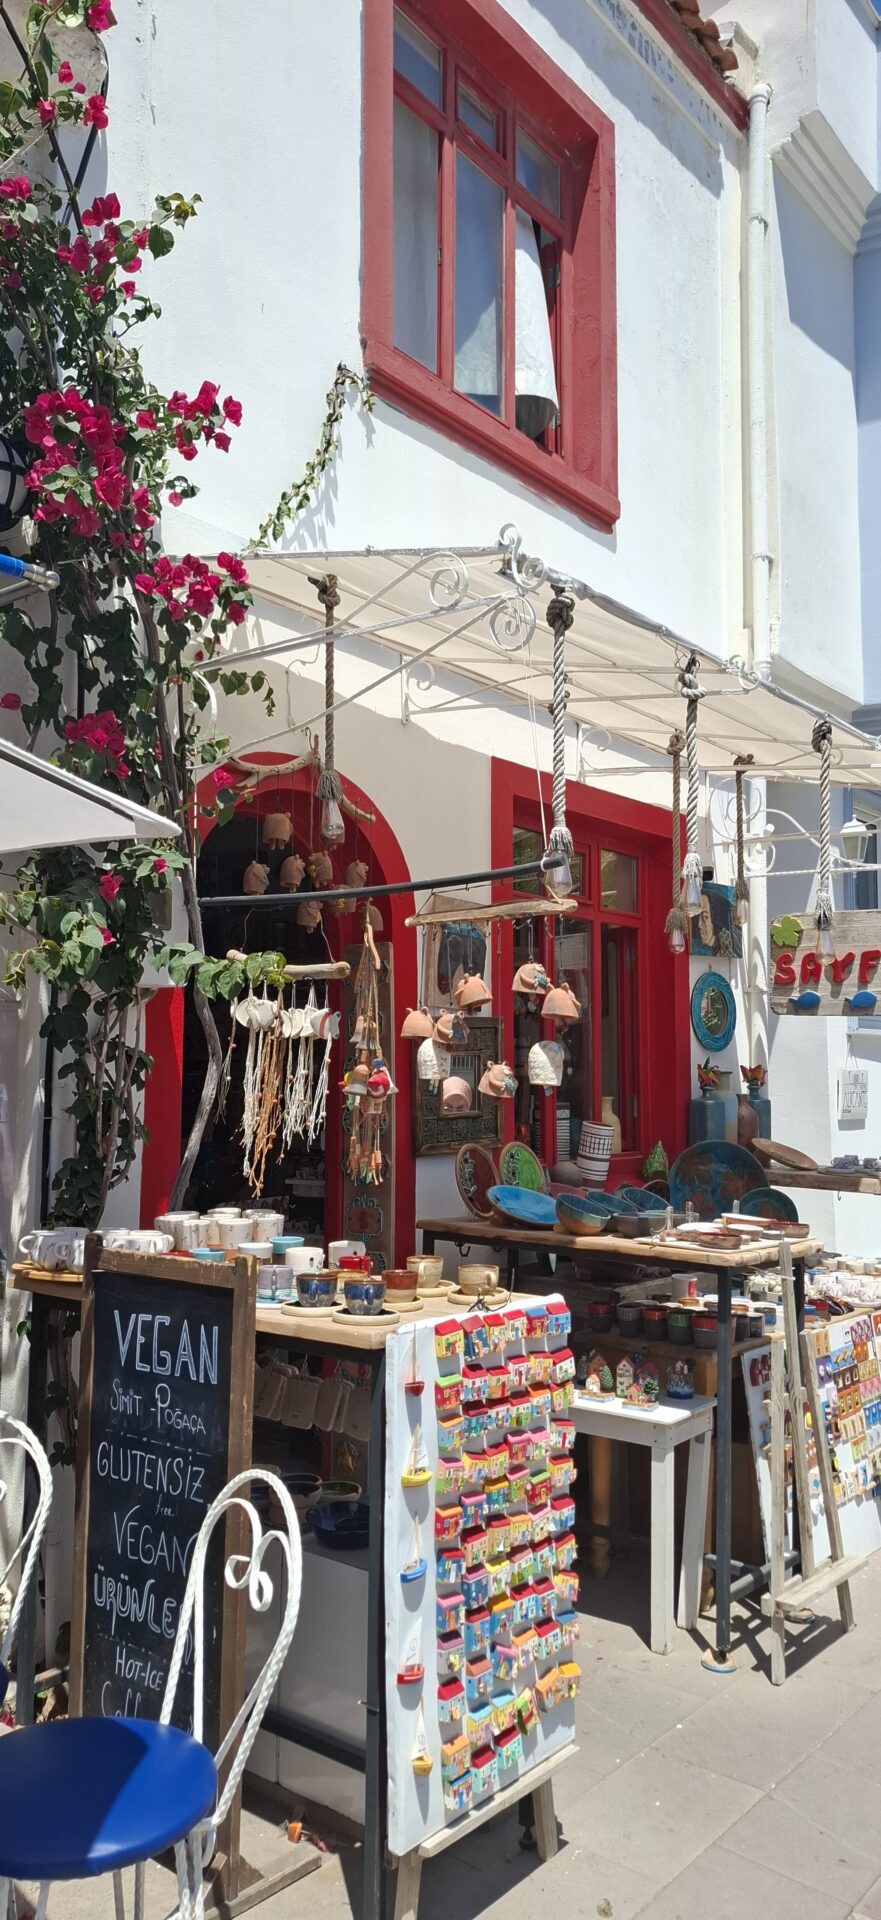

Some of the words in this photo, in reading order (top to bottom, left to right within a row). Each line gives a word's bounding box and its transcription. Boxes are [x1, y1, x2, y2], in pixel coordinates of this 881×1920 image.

[113, 1309, 219, 1385] VEGAN
[113, 1504, 200, 1577] VEGAN
[93, 1563, 193, 1665] ÜRÜNLE
[115, 1645, 165, 1691] HOT-ICE
